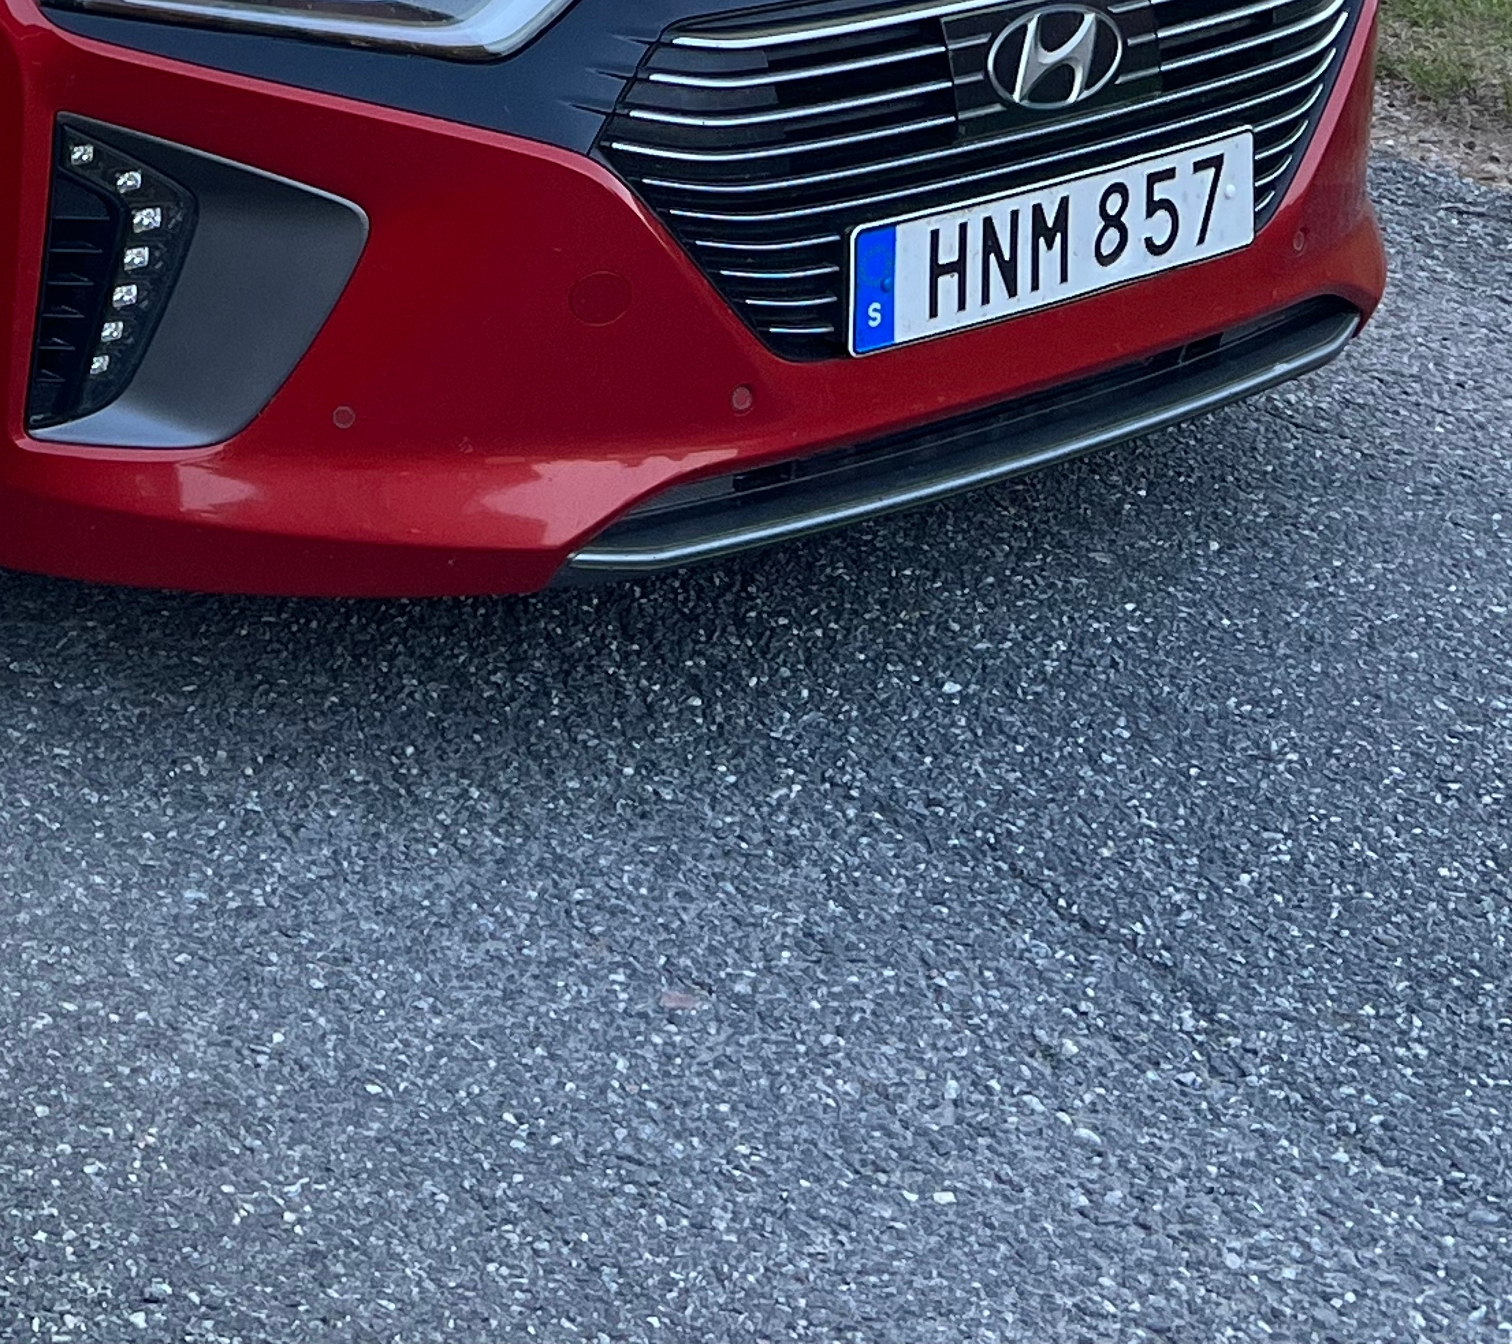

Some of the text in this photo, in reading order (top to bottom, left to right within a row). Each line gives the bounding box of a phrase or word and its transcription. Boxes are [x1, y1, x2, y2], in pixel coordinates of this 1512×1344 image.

[928, 154, 1225, 320] HNM 857
[867, 303, 882, 328] S
